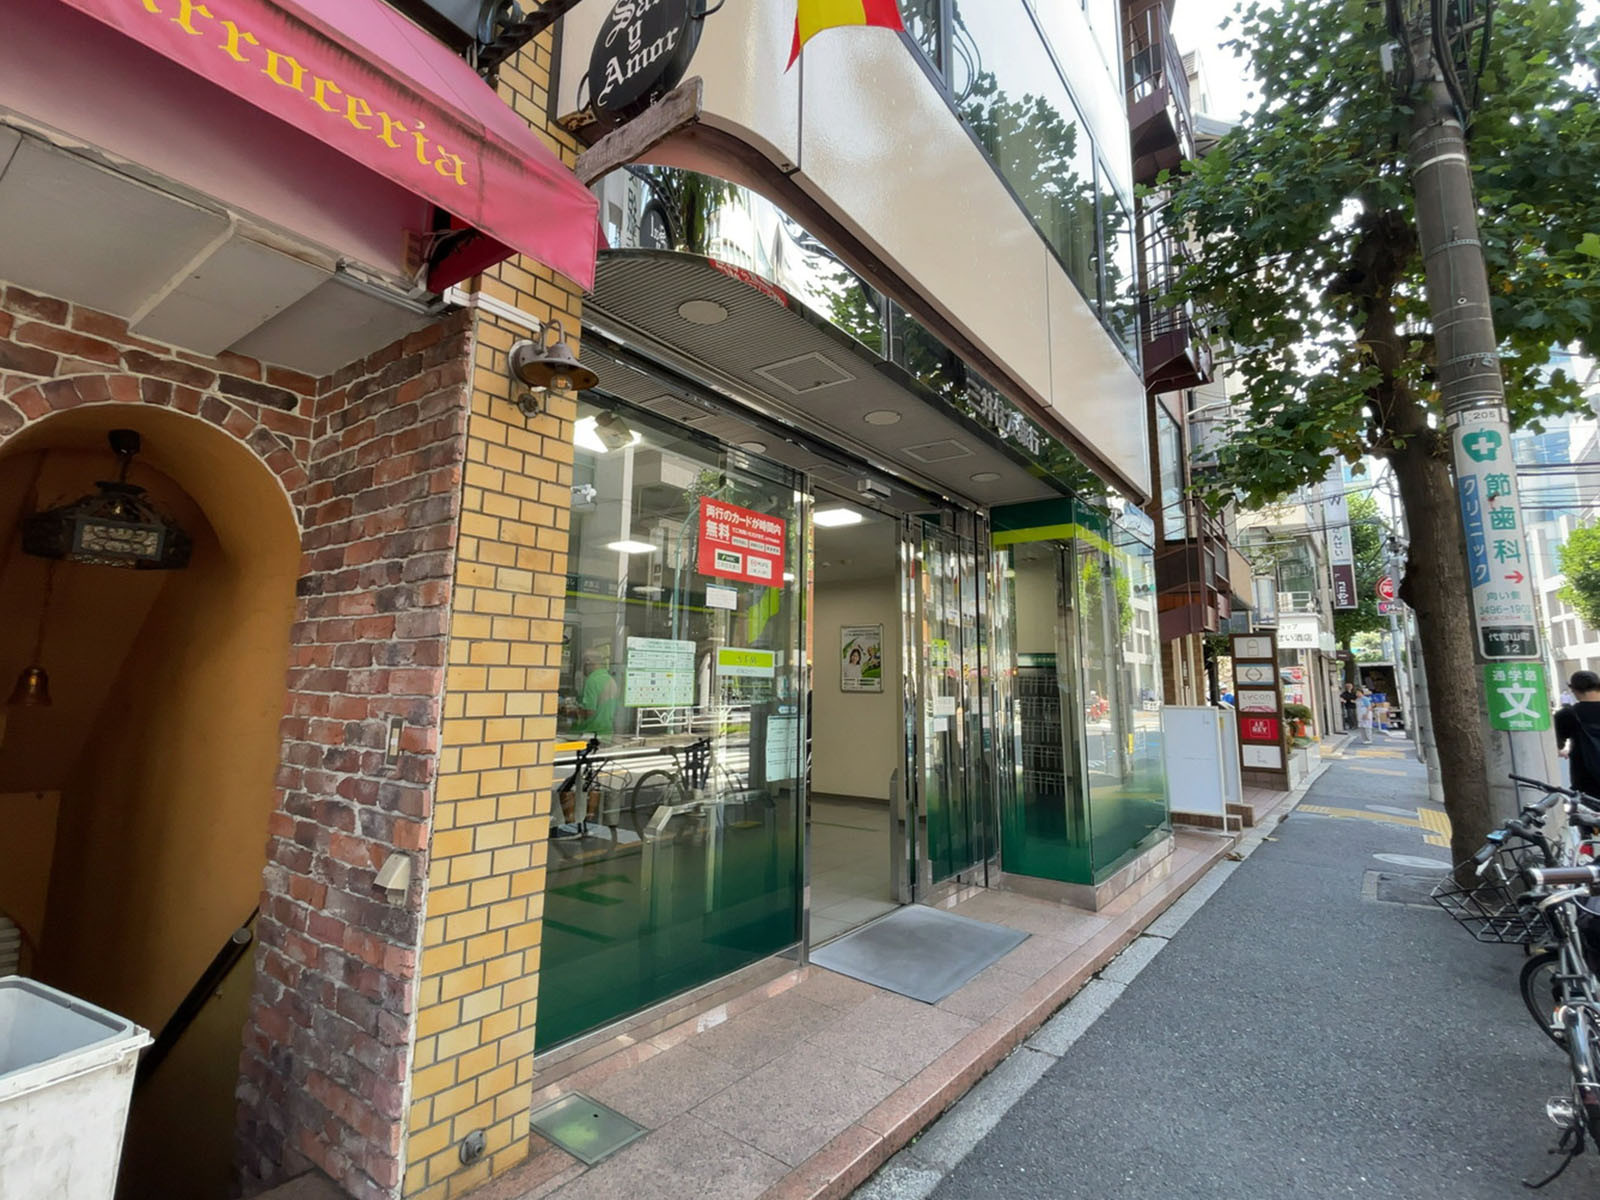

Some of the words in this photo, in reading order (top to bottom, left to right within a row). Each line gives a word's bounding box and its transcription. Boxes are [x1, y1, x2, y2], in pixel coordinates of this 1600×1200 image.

[627, 20, 643, 54] y
[597, 27, 679, 107] Amor
[705, 519, 730, 541] 無料
[1464, 480, 1487, 580] クリニック
[1484, 473, 1521, 564] 節歯科
[1504, 644, 1520, 653] 12
[1497, 682, 1541, 719] 文
